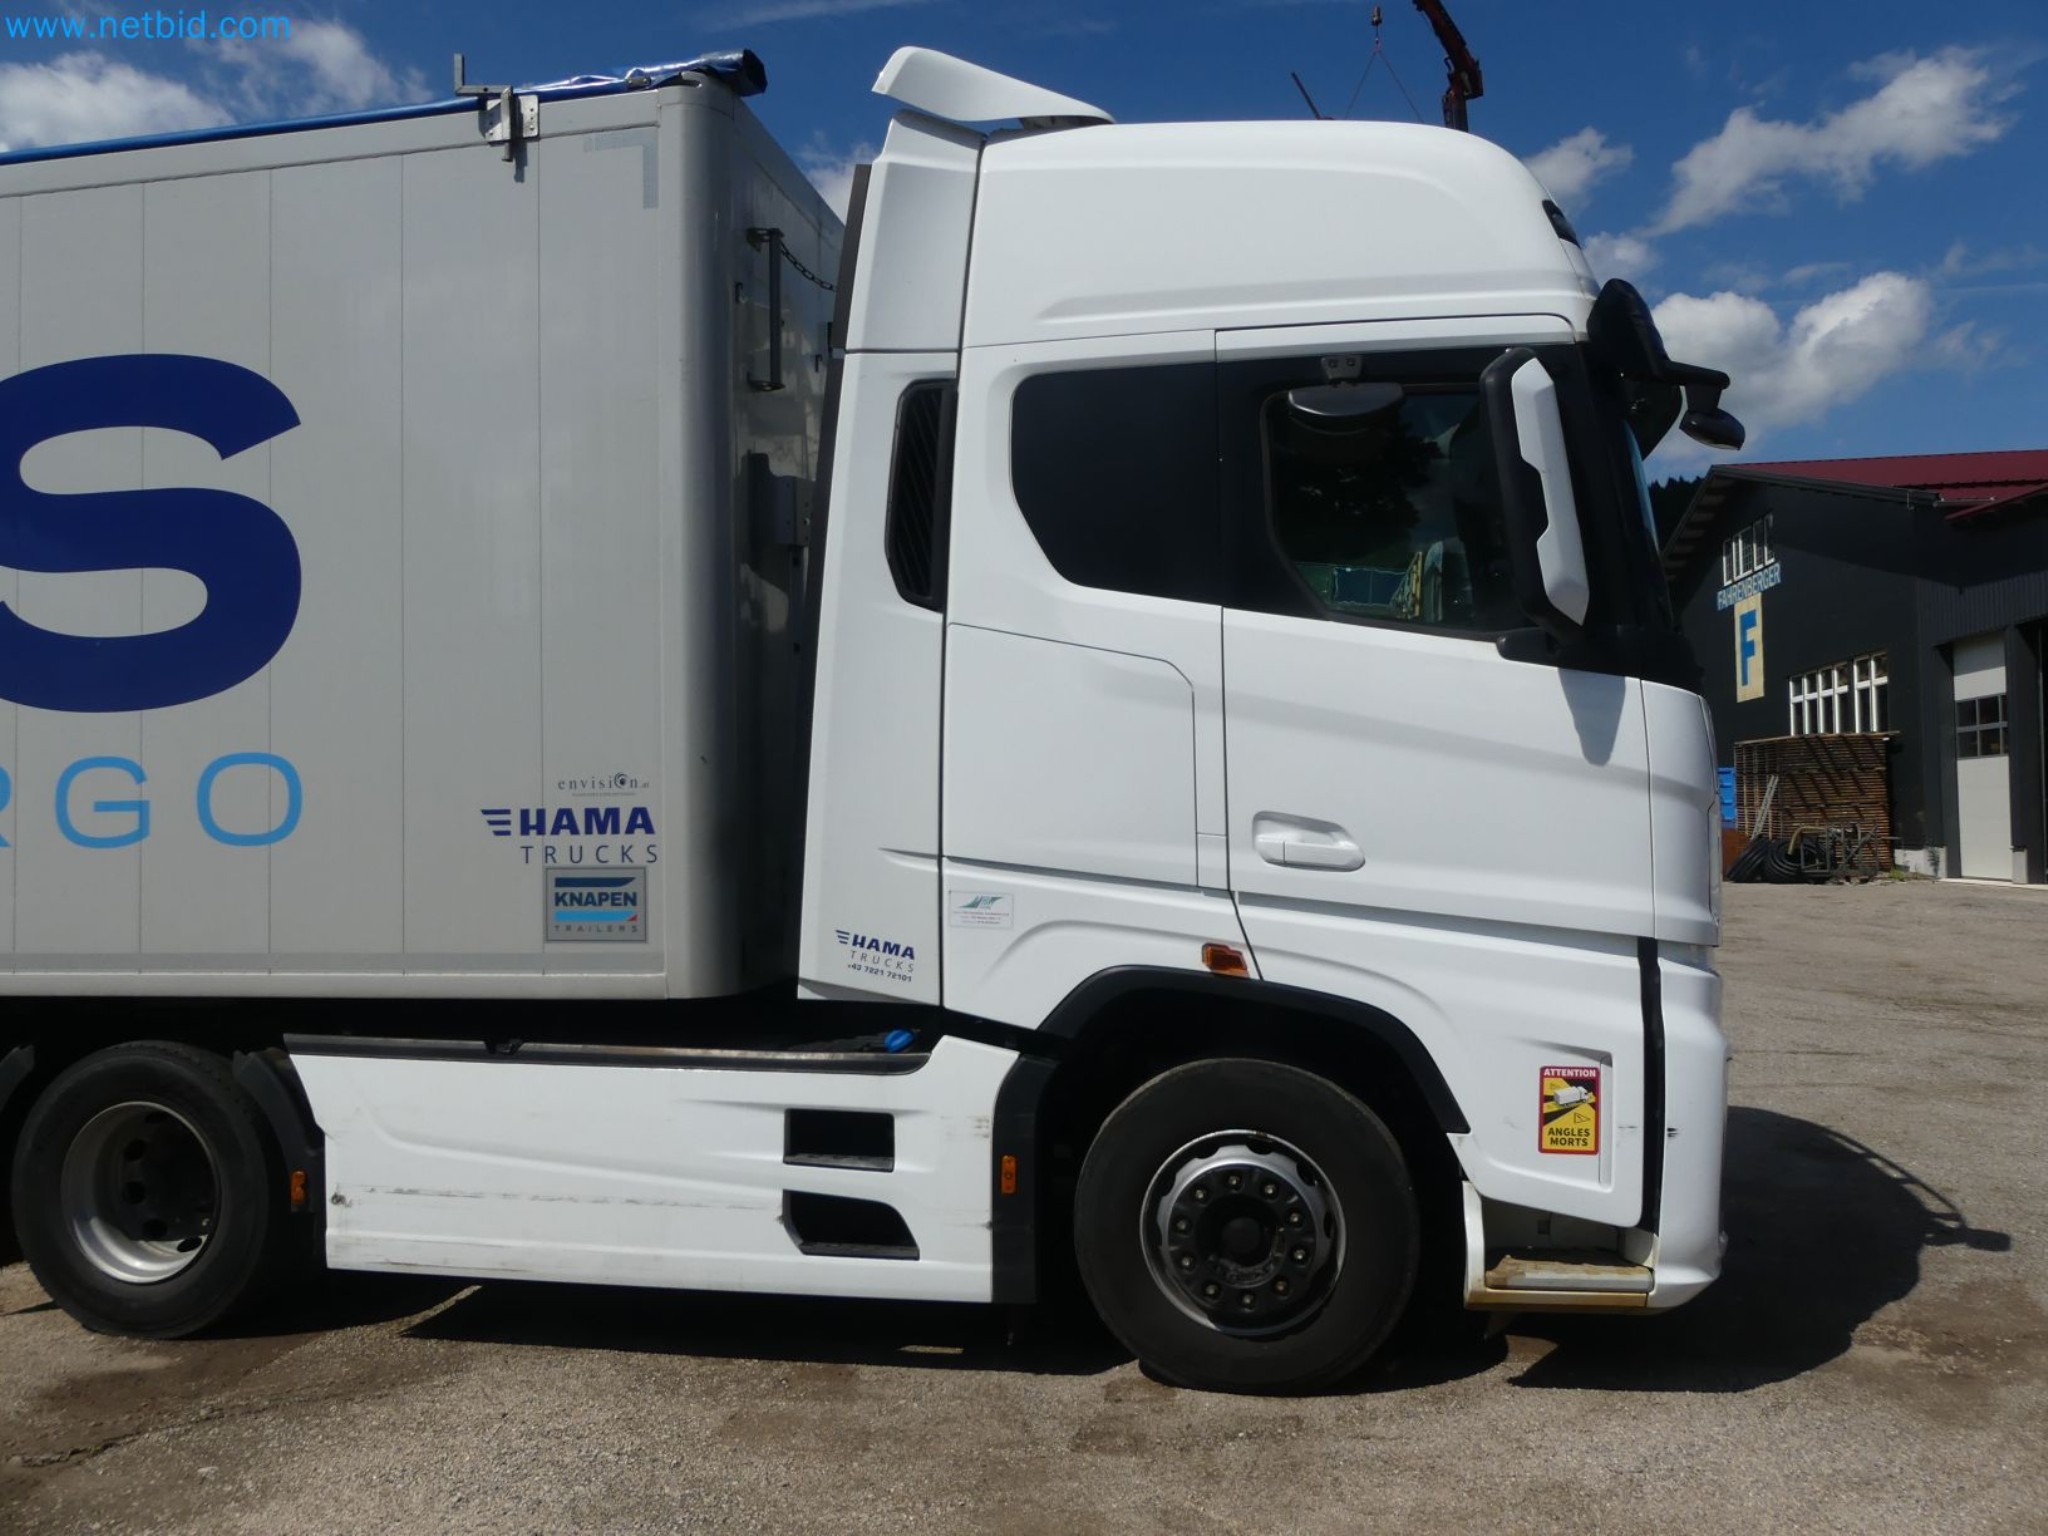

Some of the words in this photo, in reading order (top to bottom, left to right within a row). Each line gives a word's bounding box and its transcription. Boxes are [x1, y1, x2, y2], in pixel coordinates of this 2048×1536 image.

[1717, 562, 1781, 610] FAHRENBERGER
[1739, 609, 1757, 686] F
[0, 752, 302, 848] GO
[520, 807, 655, 835] HAMA
[520, 844, 658, 864] TRUCKS
[554, 891, 638, 907] KNAPEN
[554, 925, 638, 933] TRAILERS
[852, 934, 915, 960] HAMA
[850, 950, 915, 973] TRUCKS
[1544, 1068, 1596, 1077] ATTENTION
[1548, 1127, 1590, 1137] ANGLES
[1550, 1137, 1588, 1146] MORTS
